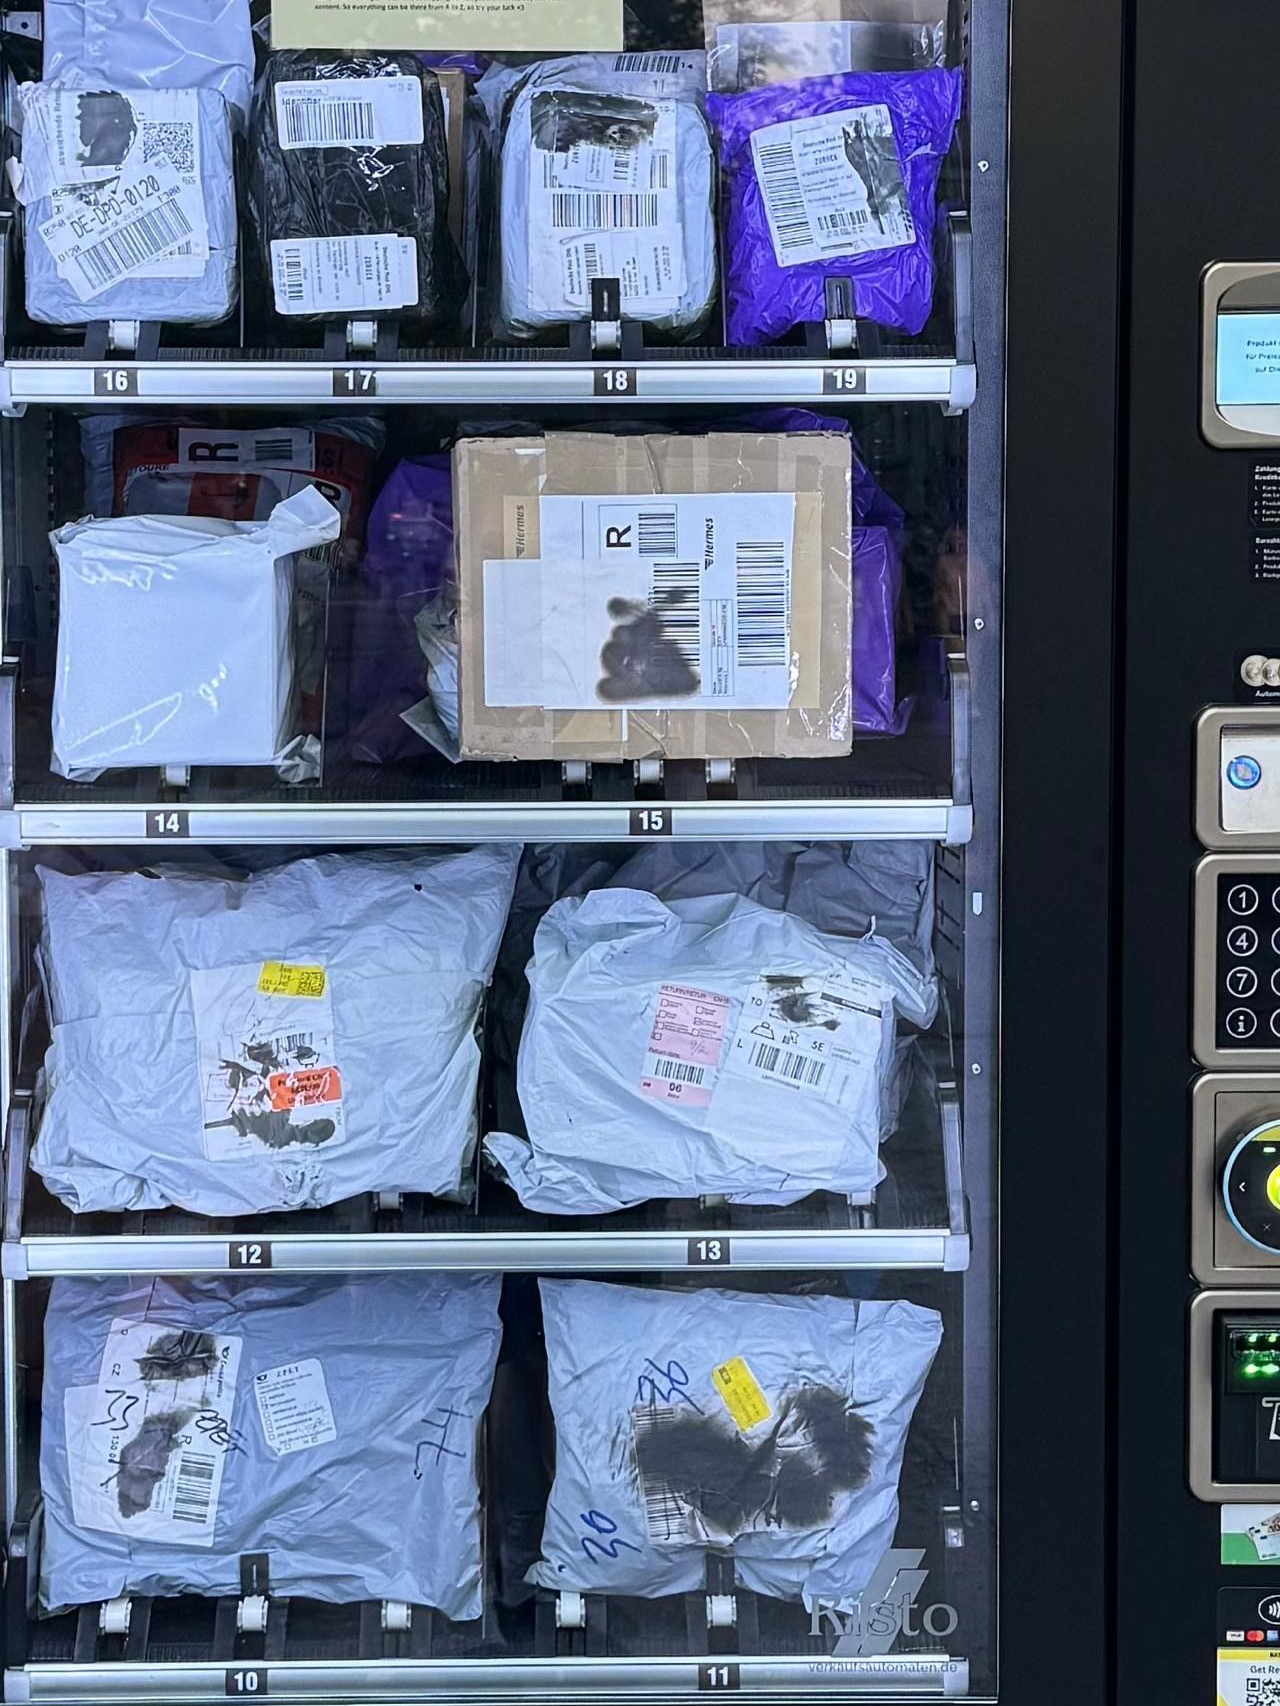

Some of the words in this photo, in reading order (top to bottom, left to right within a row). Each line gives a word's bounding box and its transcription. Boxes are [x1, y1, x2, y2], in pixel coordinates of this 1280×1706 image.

[70, 175, 160, 238] DE-DPD-0120
[102, 371, 127, 390] 16
[603, 371, 628, 390] 18
[832, 370, 857, 390] 19
[188, 442, 239, 462] R
[606, 525, 632, 548] R
[705, 517, 715, 561] Hermes
[155, 813, 180, 833] 14
[639, 811, 663, 831] 15
[1238, 892, 1248, 908] 1
[1236, 933, 1248, 949] 4
[1236, 974, 1248, 990] 7
[751, 996, 763, 1007] TO
[811, 1040, 825, 1052] SE
[238, 1244, 262, 1264] 12
[697, 1241, 721, 1260] 13
[808, 1592, 959, 1636] Risto
[808, 1660, 958, 1673] verkaufsautomaten.de
[1250, 1665, 1266, 1673] Get
[234, 1672, 258, 1691] 10
[707, 1668, 729, 1687] 11
